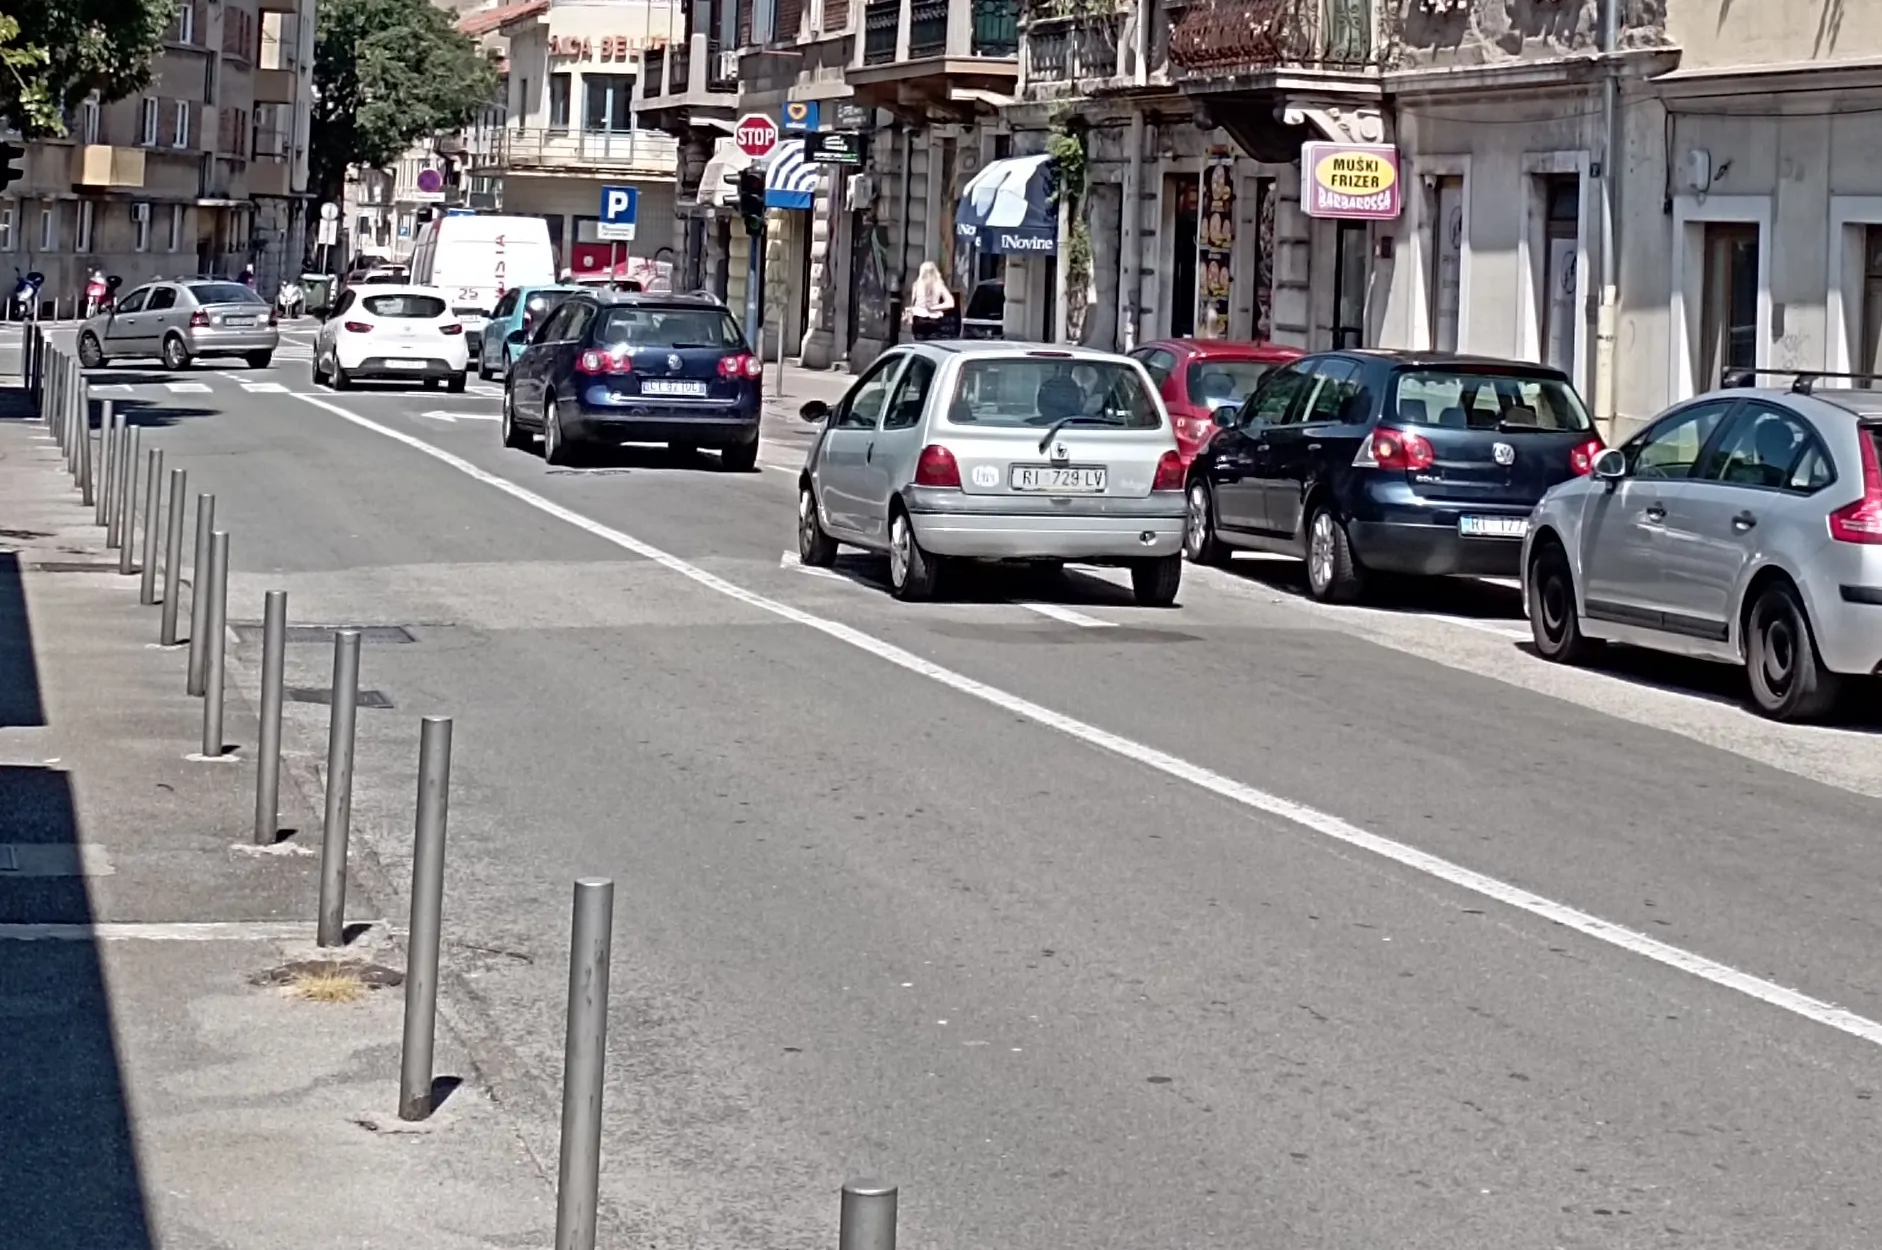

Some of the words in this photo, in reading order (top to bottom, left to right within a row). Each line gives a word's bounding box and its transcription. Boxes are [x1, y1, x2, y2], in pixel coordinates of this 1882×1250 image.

[738, 128, 774, 146] STOP
[1333, 156, 1378, 173] MUŠKI
[1331, 174, 1379, 188] FRIZER
[607, 190, 629, 219] P
[458, 288, 478, 300] 25
[1022, 470, 1039, 486] RI
[1051, 470, 1080, 486] 729
[1085, 470, 1103, 486] LV
